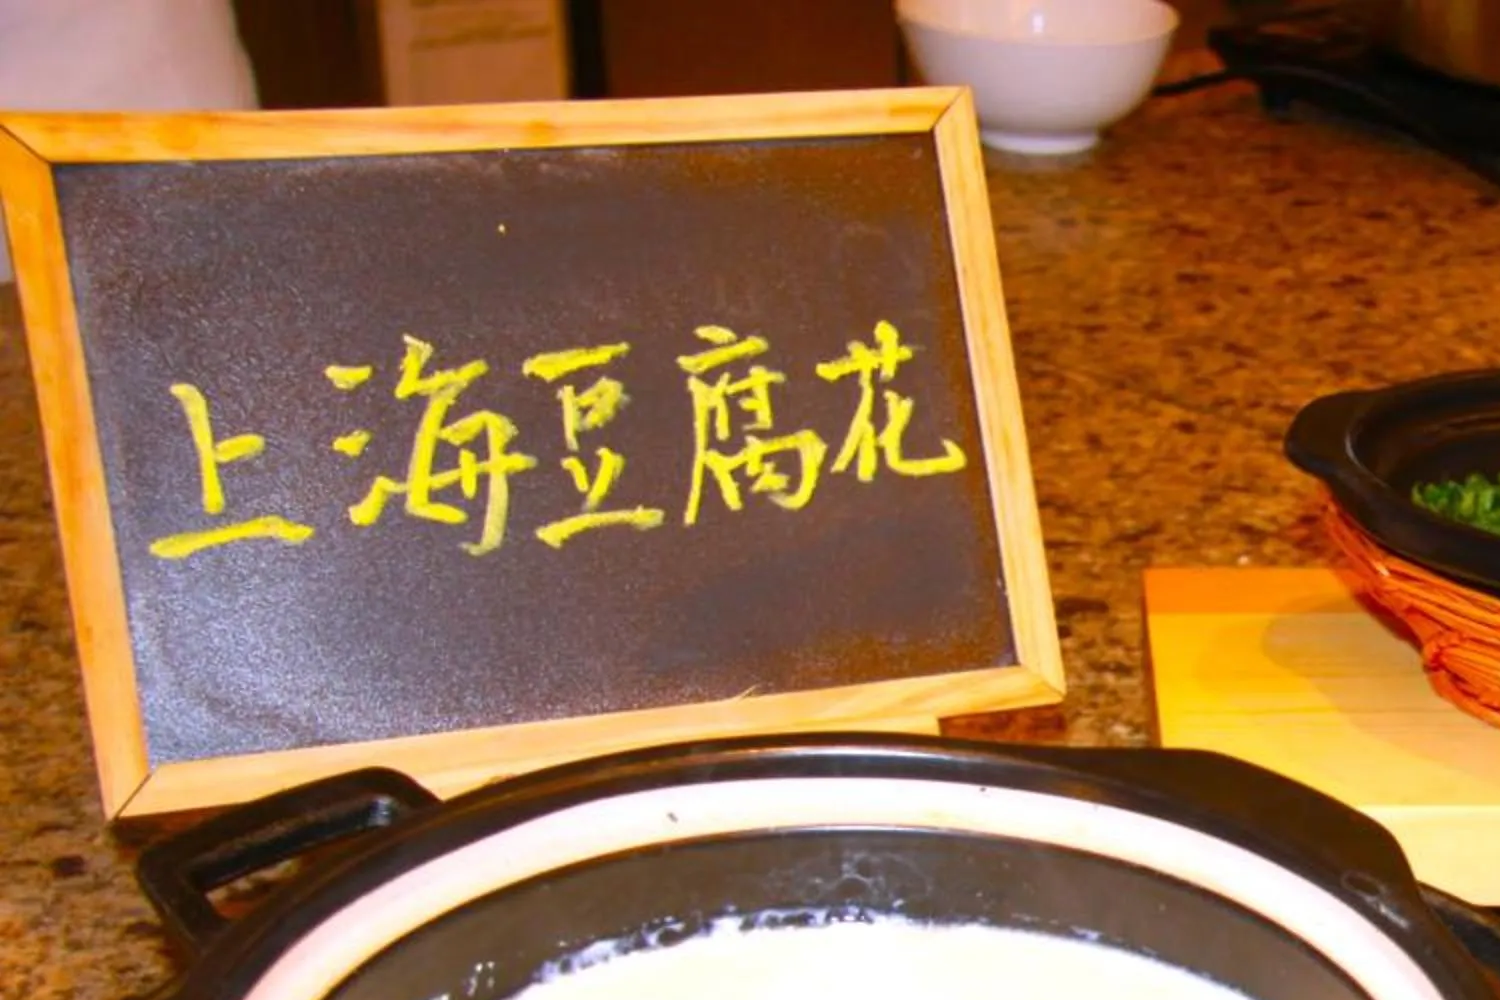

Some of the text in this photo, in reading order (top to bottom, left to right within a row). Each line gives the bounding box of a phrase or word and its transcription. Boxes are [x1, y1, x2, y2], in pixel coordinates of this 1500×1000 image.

[149, 321, 966, 556] 上海豆腐花
